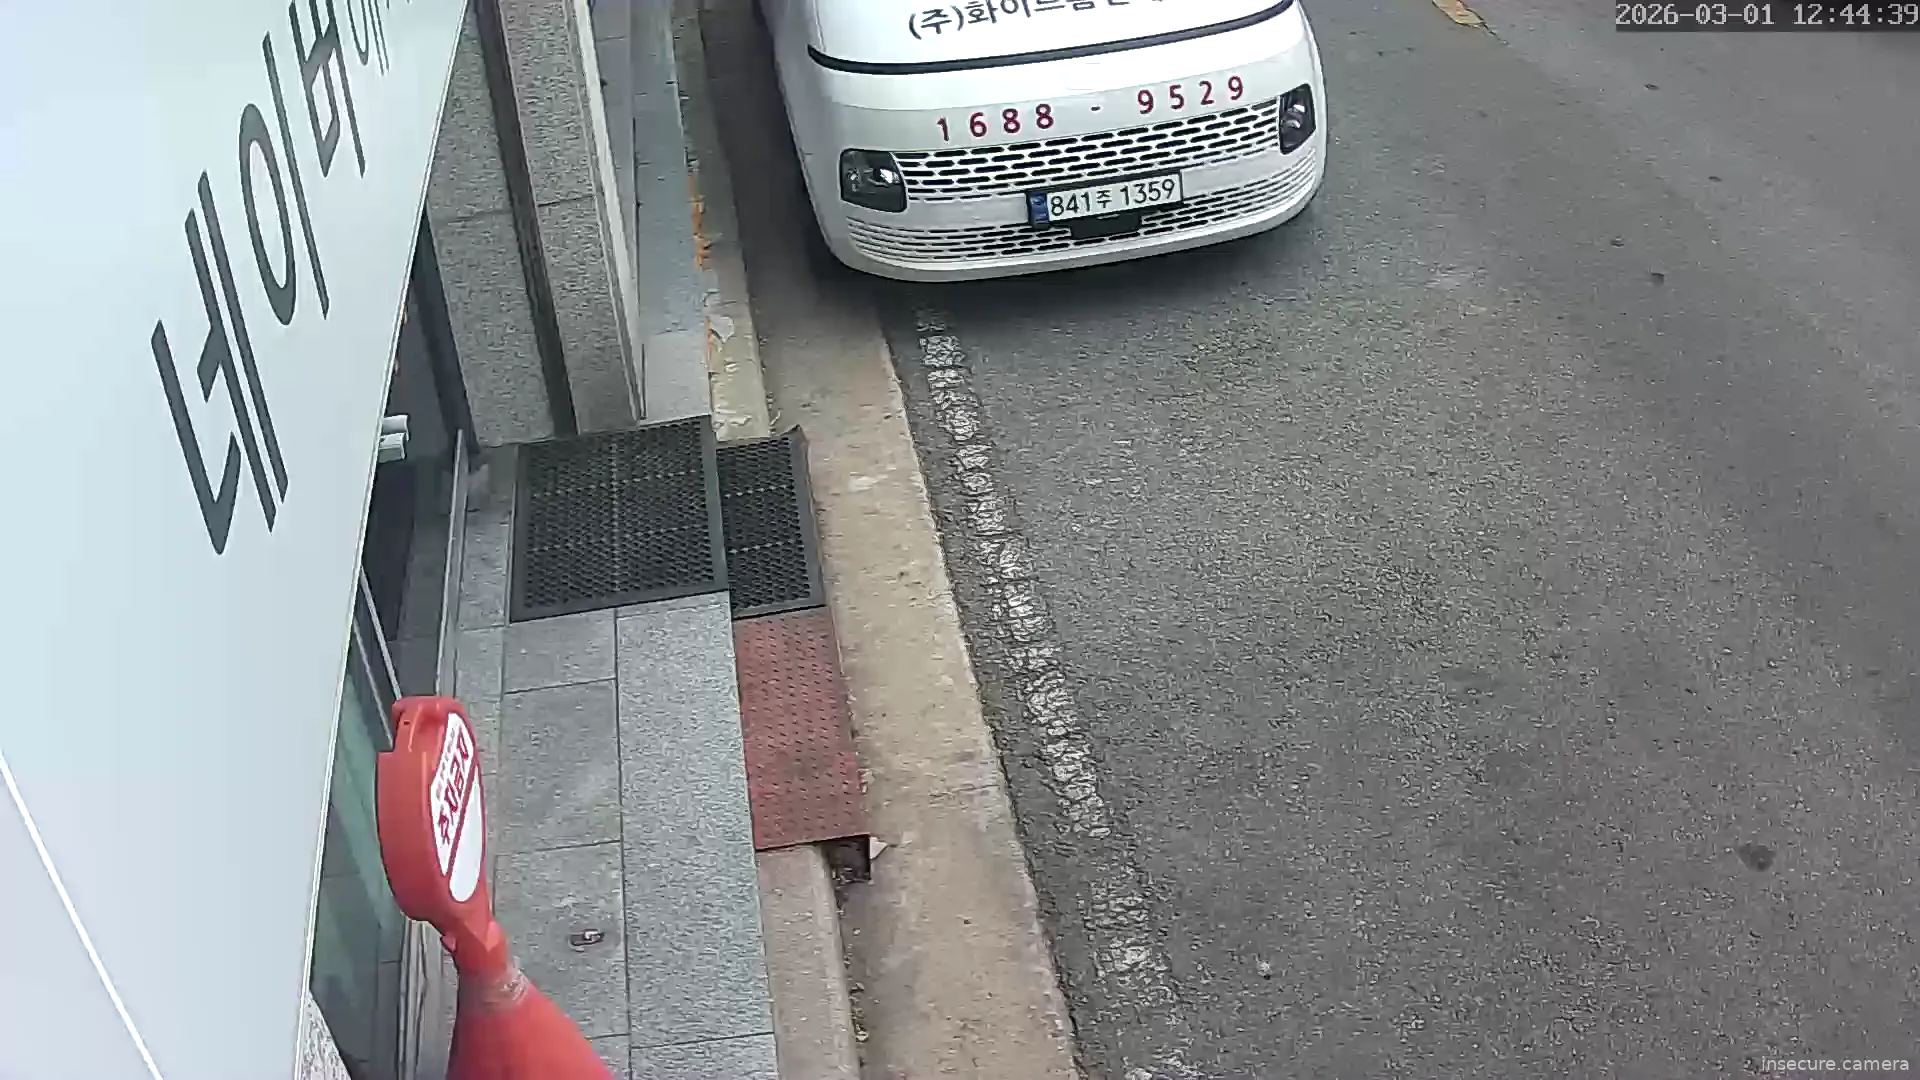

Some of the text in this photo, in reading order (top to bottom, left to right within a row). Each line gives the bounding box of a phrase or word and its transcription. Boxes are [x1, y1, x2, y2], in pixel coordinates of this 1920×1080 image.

[936, 103, 1054, 142] 1688
[1137, 75, 1244, 114] 9529
[1120, 178, 1175, 206] 1359
[151, 0, 411, 554] 네이버
